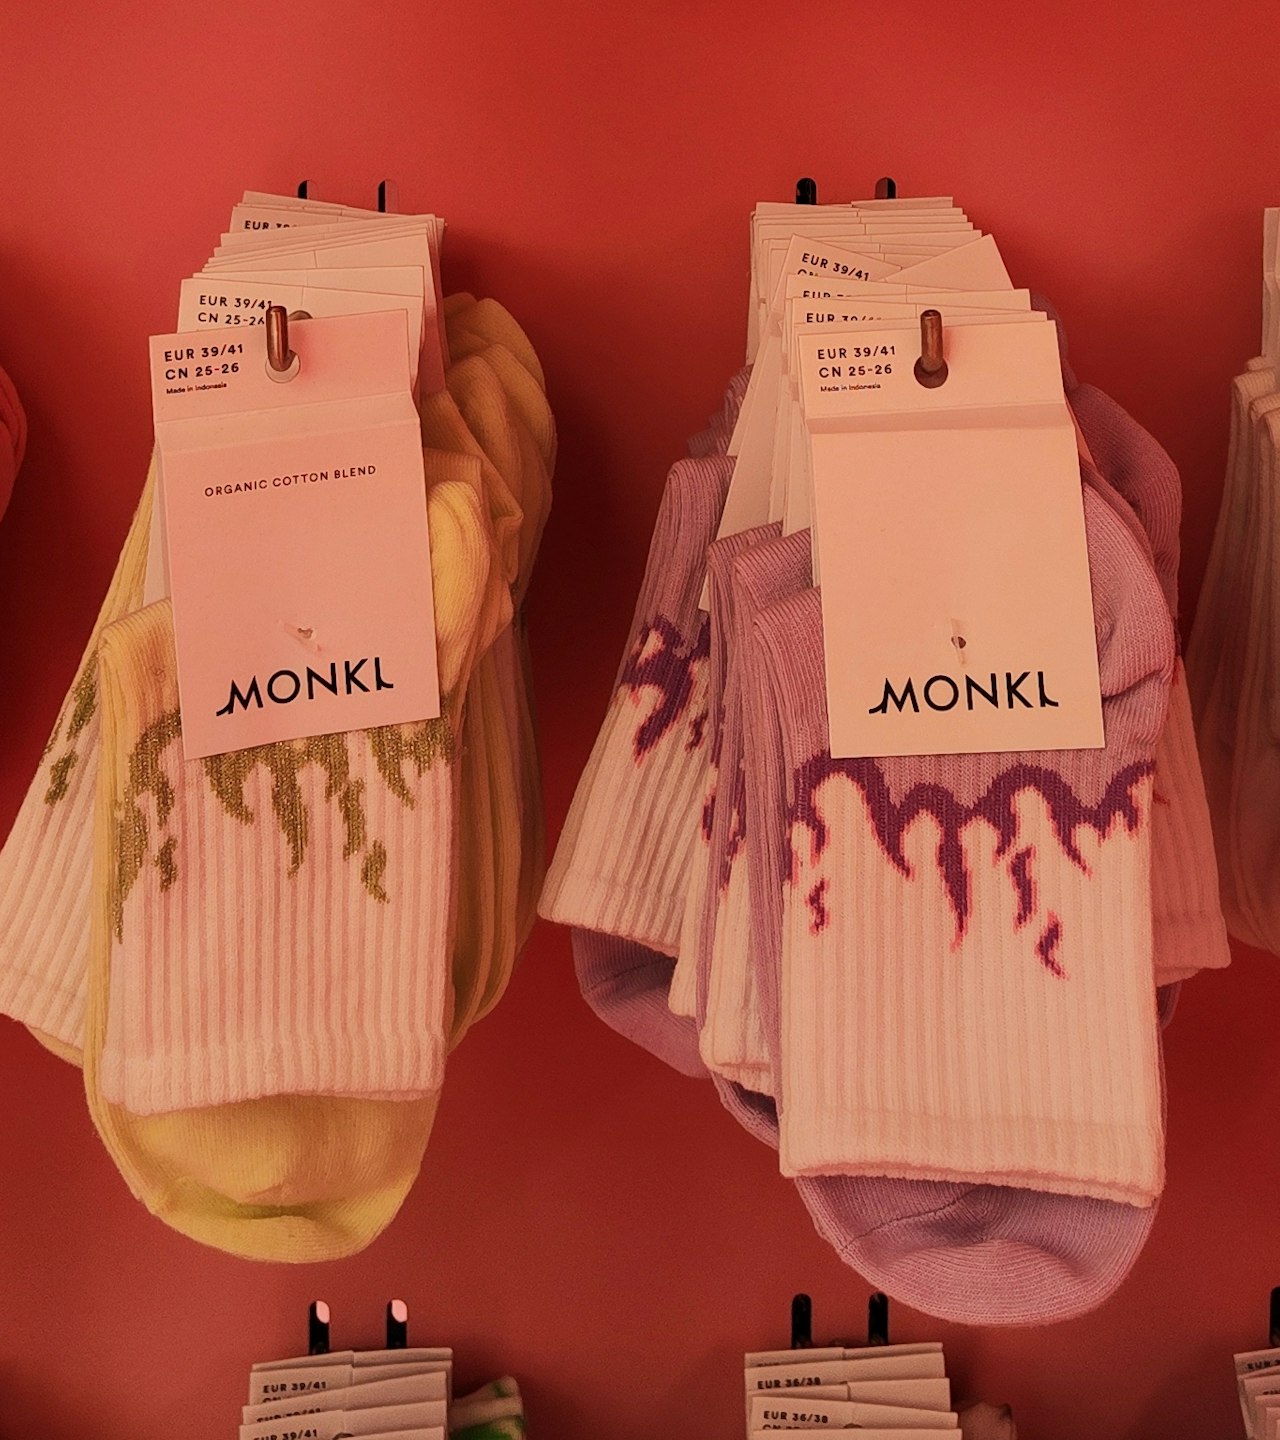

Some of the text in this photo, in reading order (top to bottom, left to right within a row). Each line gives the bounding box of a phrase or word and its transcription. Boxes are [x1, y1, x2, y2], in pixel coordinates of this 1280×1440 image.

[245, 220, 269, 230] EUR
[802, 253, 870, 281] EUR 39/41
[199, 295, 228, 306] EUR
[198, 312, 218, 323] CN
[806, 313, 835, 323] EUR
[165, 344, 243, 362] EUR 39/41
[817, 346, 896, 359] EUR 39/41
[165, 363, 239, 380] CN 25-26
[819, 364, 892, 378] CN 25-26
[204, 465, 377, 497] ORGANIC COTTON BLEND
[263, 1381, 326, 1393] EUR 39/41
[758, 1380, 782, 1389] EUR
[764, 1410, 788, 1420] EUR
